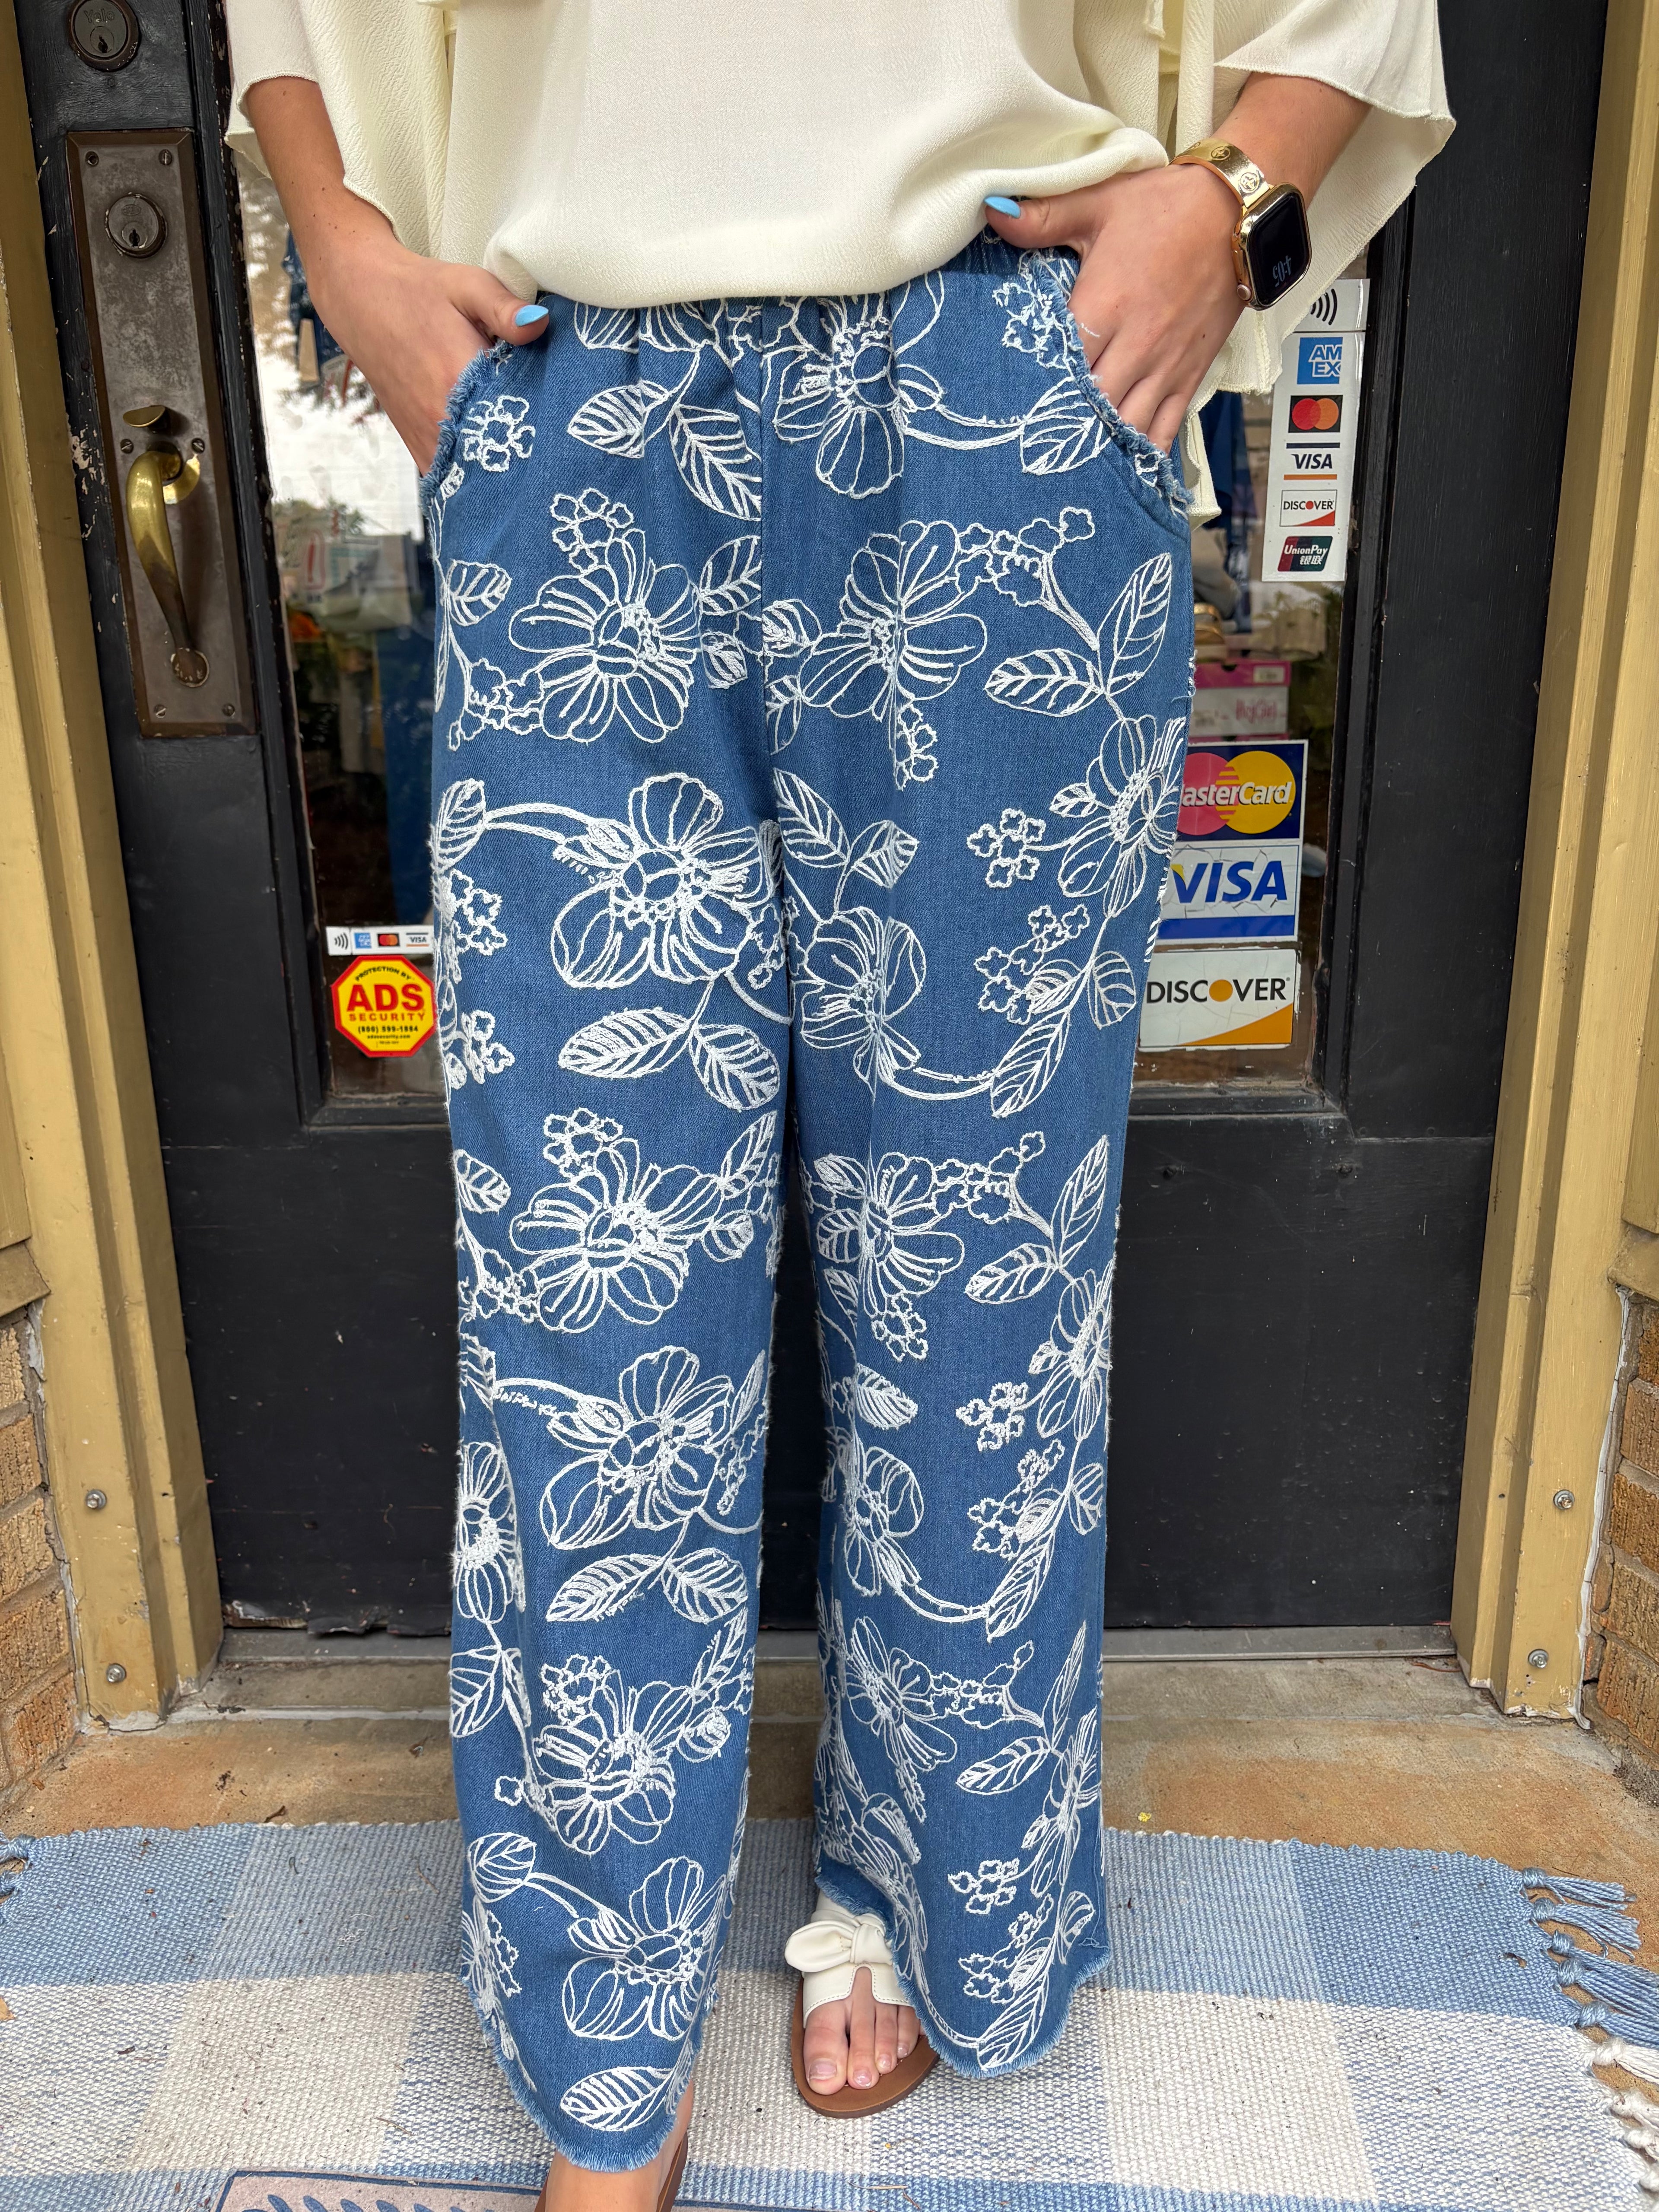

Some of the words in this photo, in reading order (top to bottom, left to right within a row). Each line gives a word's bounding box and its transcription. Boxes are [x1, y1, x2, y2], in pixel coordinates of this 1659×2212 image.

[83, 8, 114, 23] Yale
[1272, 255, 1291, 287] 4:05
[1308, 344, 1342, 362] AM
[1312, 361, 1341, 377] EX
[1290, 454, 1332, 469] VISA
[1283, 500, 1333, 510] DISCOVER
[1284, 545, 1328, 559] UnionPay
[1300, 555, 1322, 565] 银联
[1180, 782, 1292, 807] asterCard
[1170, 861, 1287, 903] VISA
[355, 966, 399, 981] PROTECTION
[401, 972, 411, 980] BY
[347, 984, 424, 1011] ADS
[1146, 978, 1287, 1004] DISCOVER
[348, 1013, 425, 1022] SECURITY
